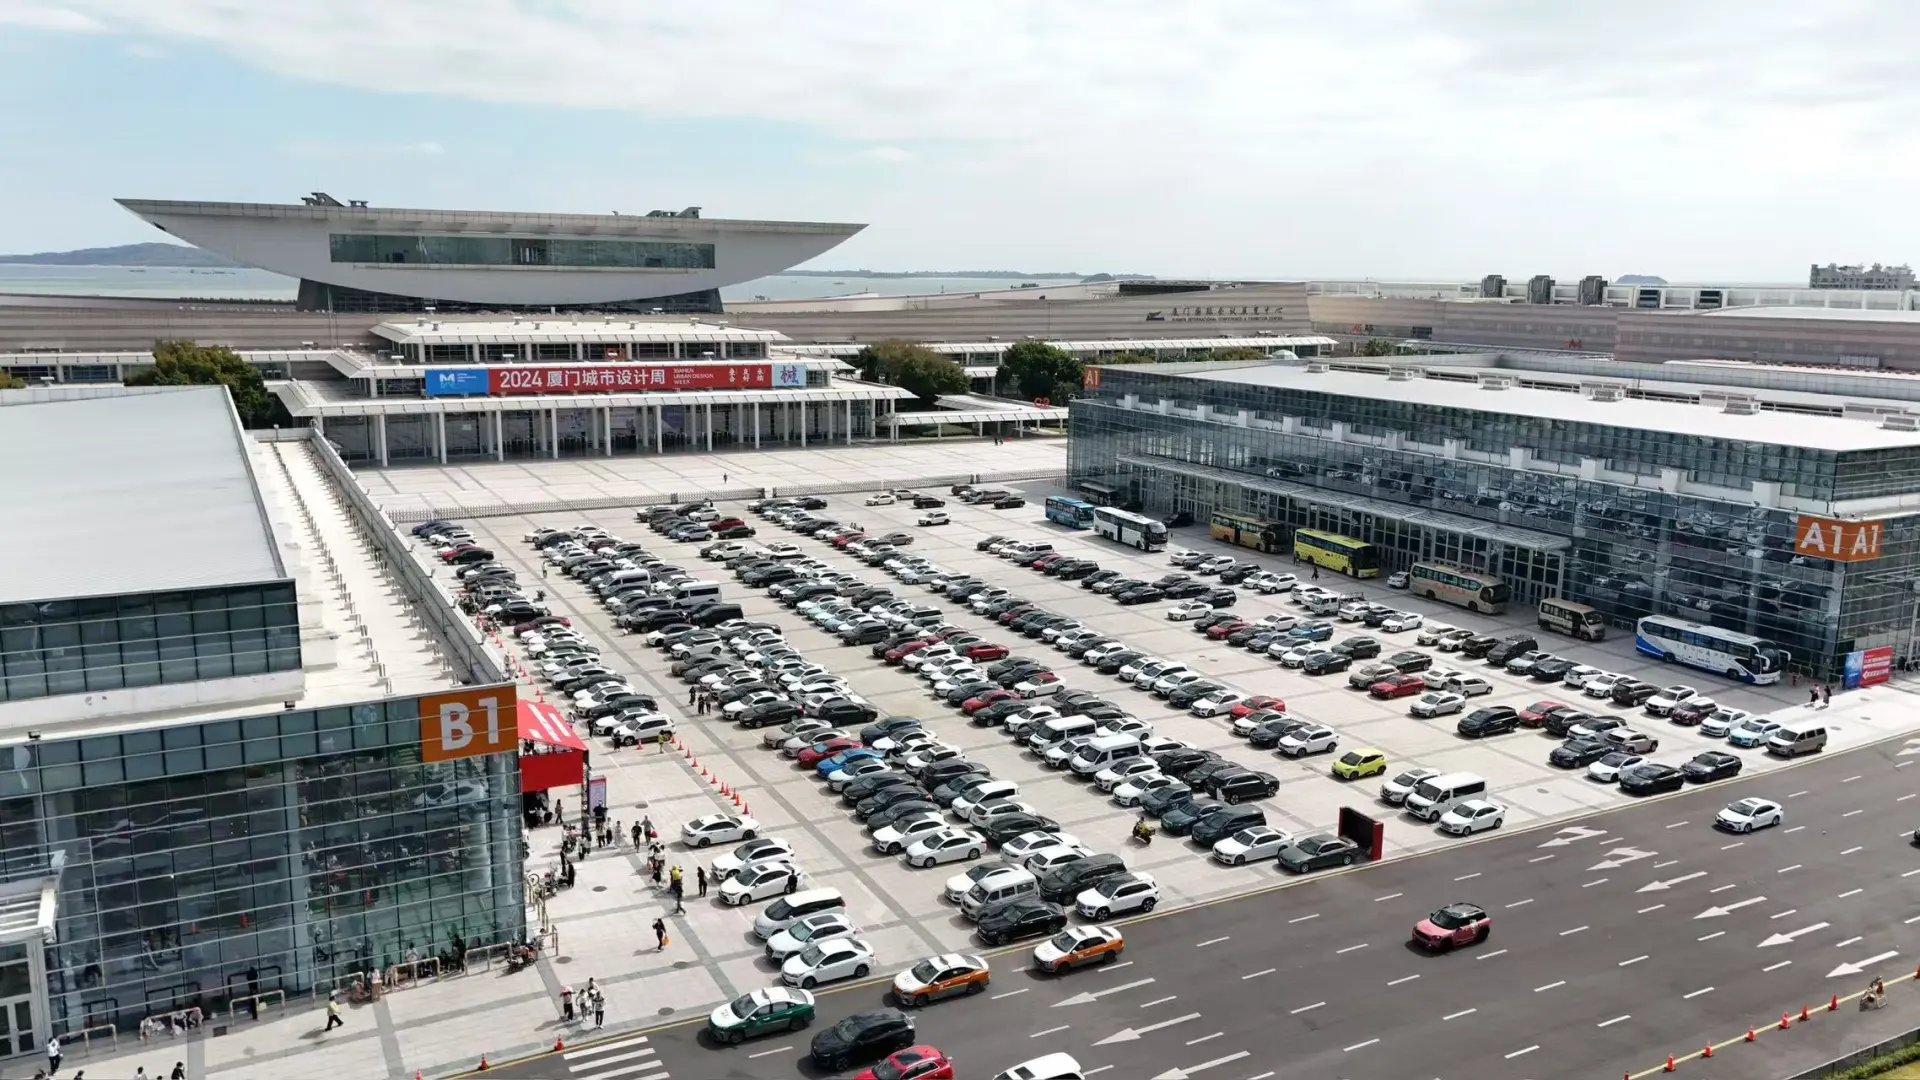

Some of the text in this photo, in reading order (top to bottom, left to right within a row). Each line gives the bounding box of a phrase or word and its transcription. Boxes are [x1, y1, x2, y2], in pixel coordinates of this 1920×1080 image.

[500, 369, 665, 388] 2024 厦门城市设计周
[1086, 370, 1098, 385] A1
[1800, 522, 1843, 554] A1
[1851, 524, 1879, 556] A1
[439, 696, 499, 751] B1
